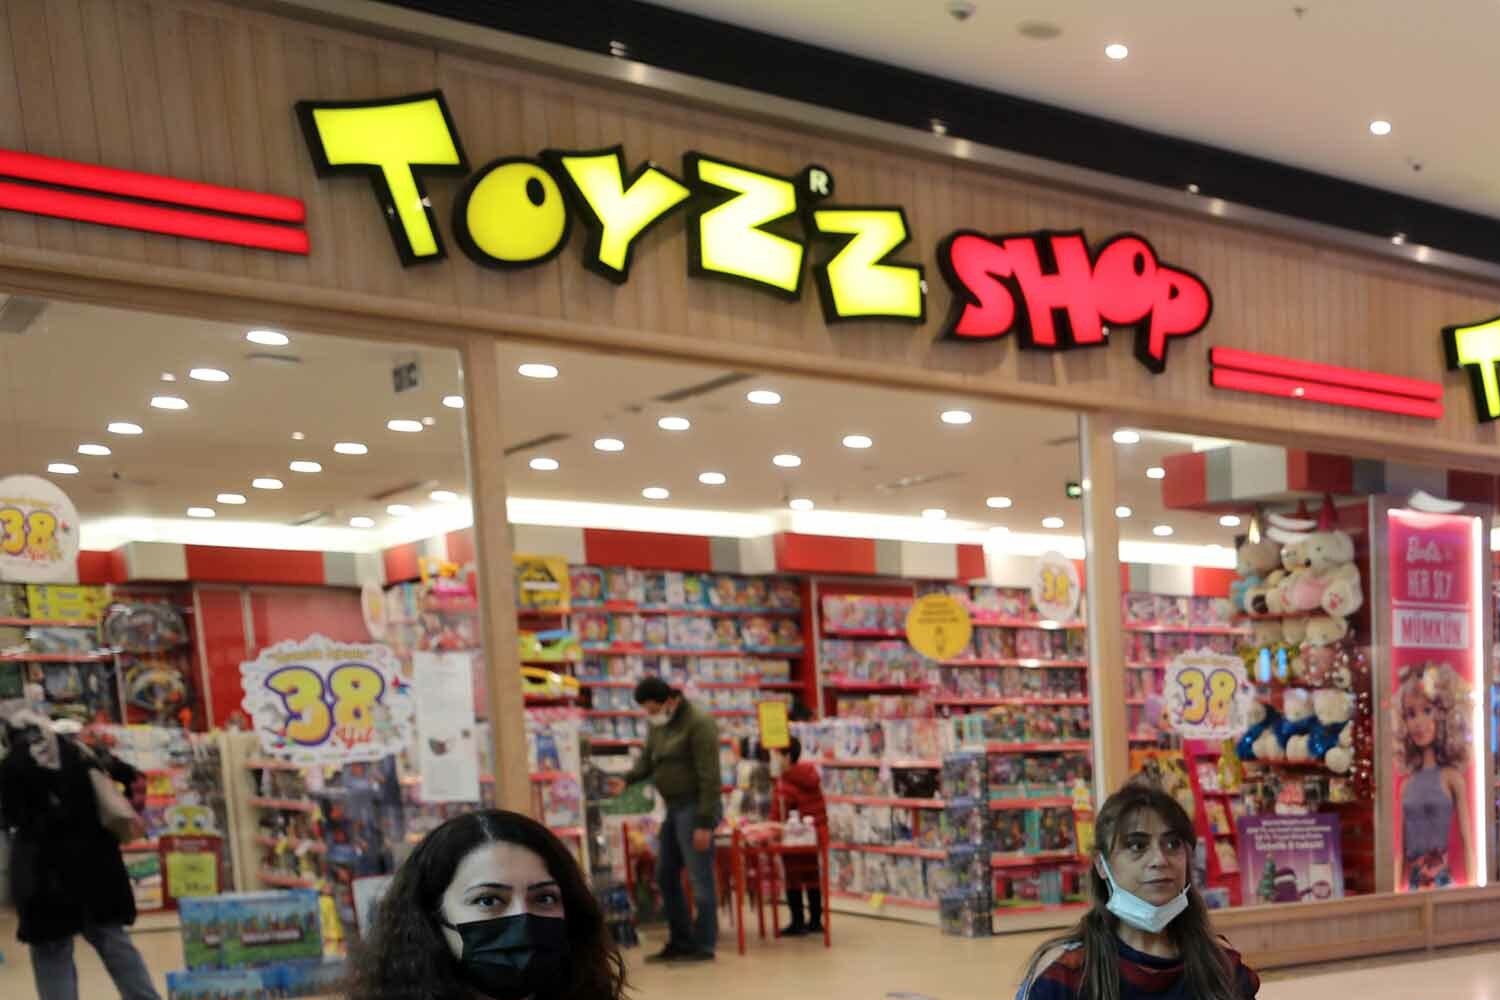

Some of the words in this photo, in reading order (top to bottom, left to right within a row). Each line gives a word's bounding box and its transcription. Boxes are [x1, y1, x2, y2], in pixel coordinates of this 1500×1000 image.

[947, 231, 1211, 368] SHOP
[264, 661, 386, 747] 38
[1175, 666, 1238, 726] 38
